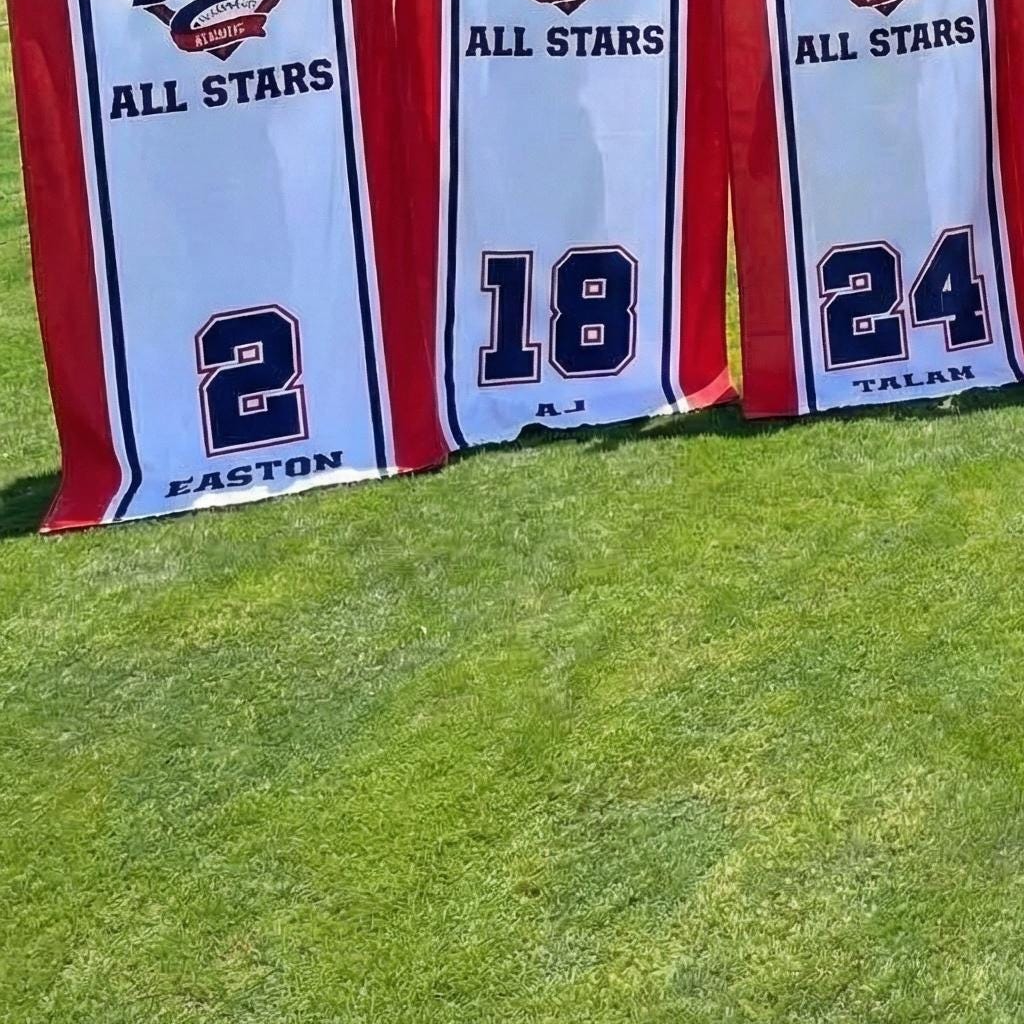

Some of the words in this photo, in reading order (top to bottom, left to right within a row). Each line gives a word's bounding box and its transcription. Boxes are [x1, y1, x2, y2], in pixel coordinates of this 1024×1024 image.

[466, 26, 533, 56] ALL
[547, 25, 664, 56] STARS
[795, 33, 858, 64] ALL
[869, 16, 975, 57] STARS
[110, 81, 188, 119] ALL
[202, 59, 334, 108] STARS
[478, 245, 638, 387] 18
[816, 225, 993, 371] 24
[195, 304, 308, 458] 2
[165, 451, 343, 498] EASTON
